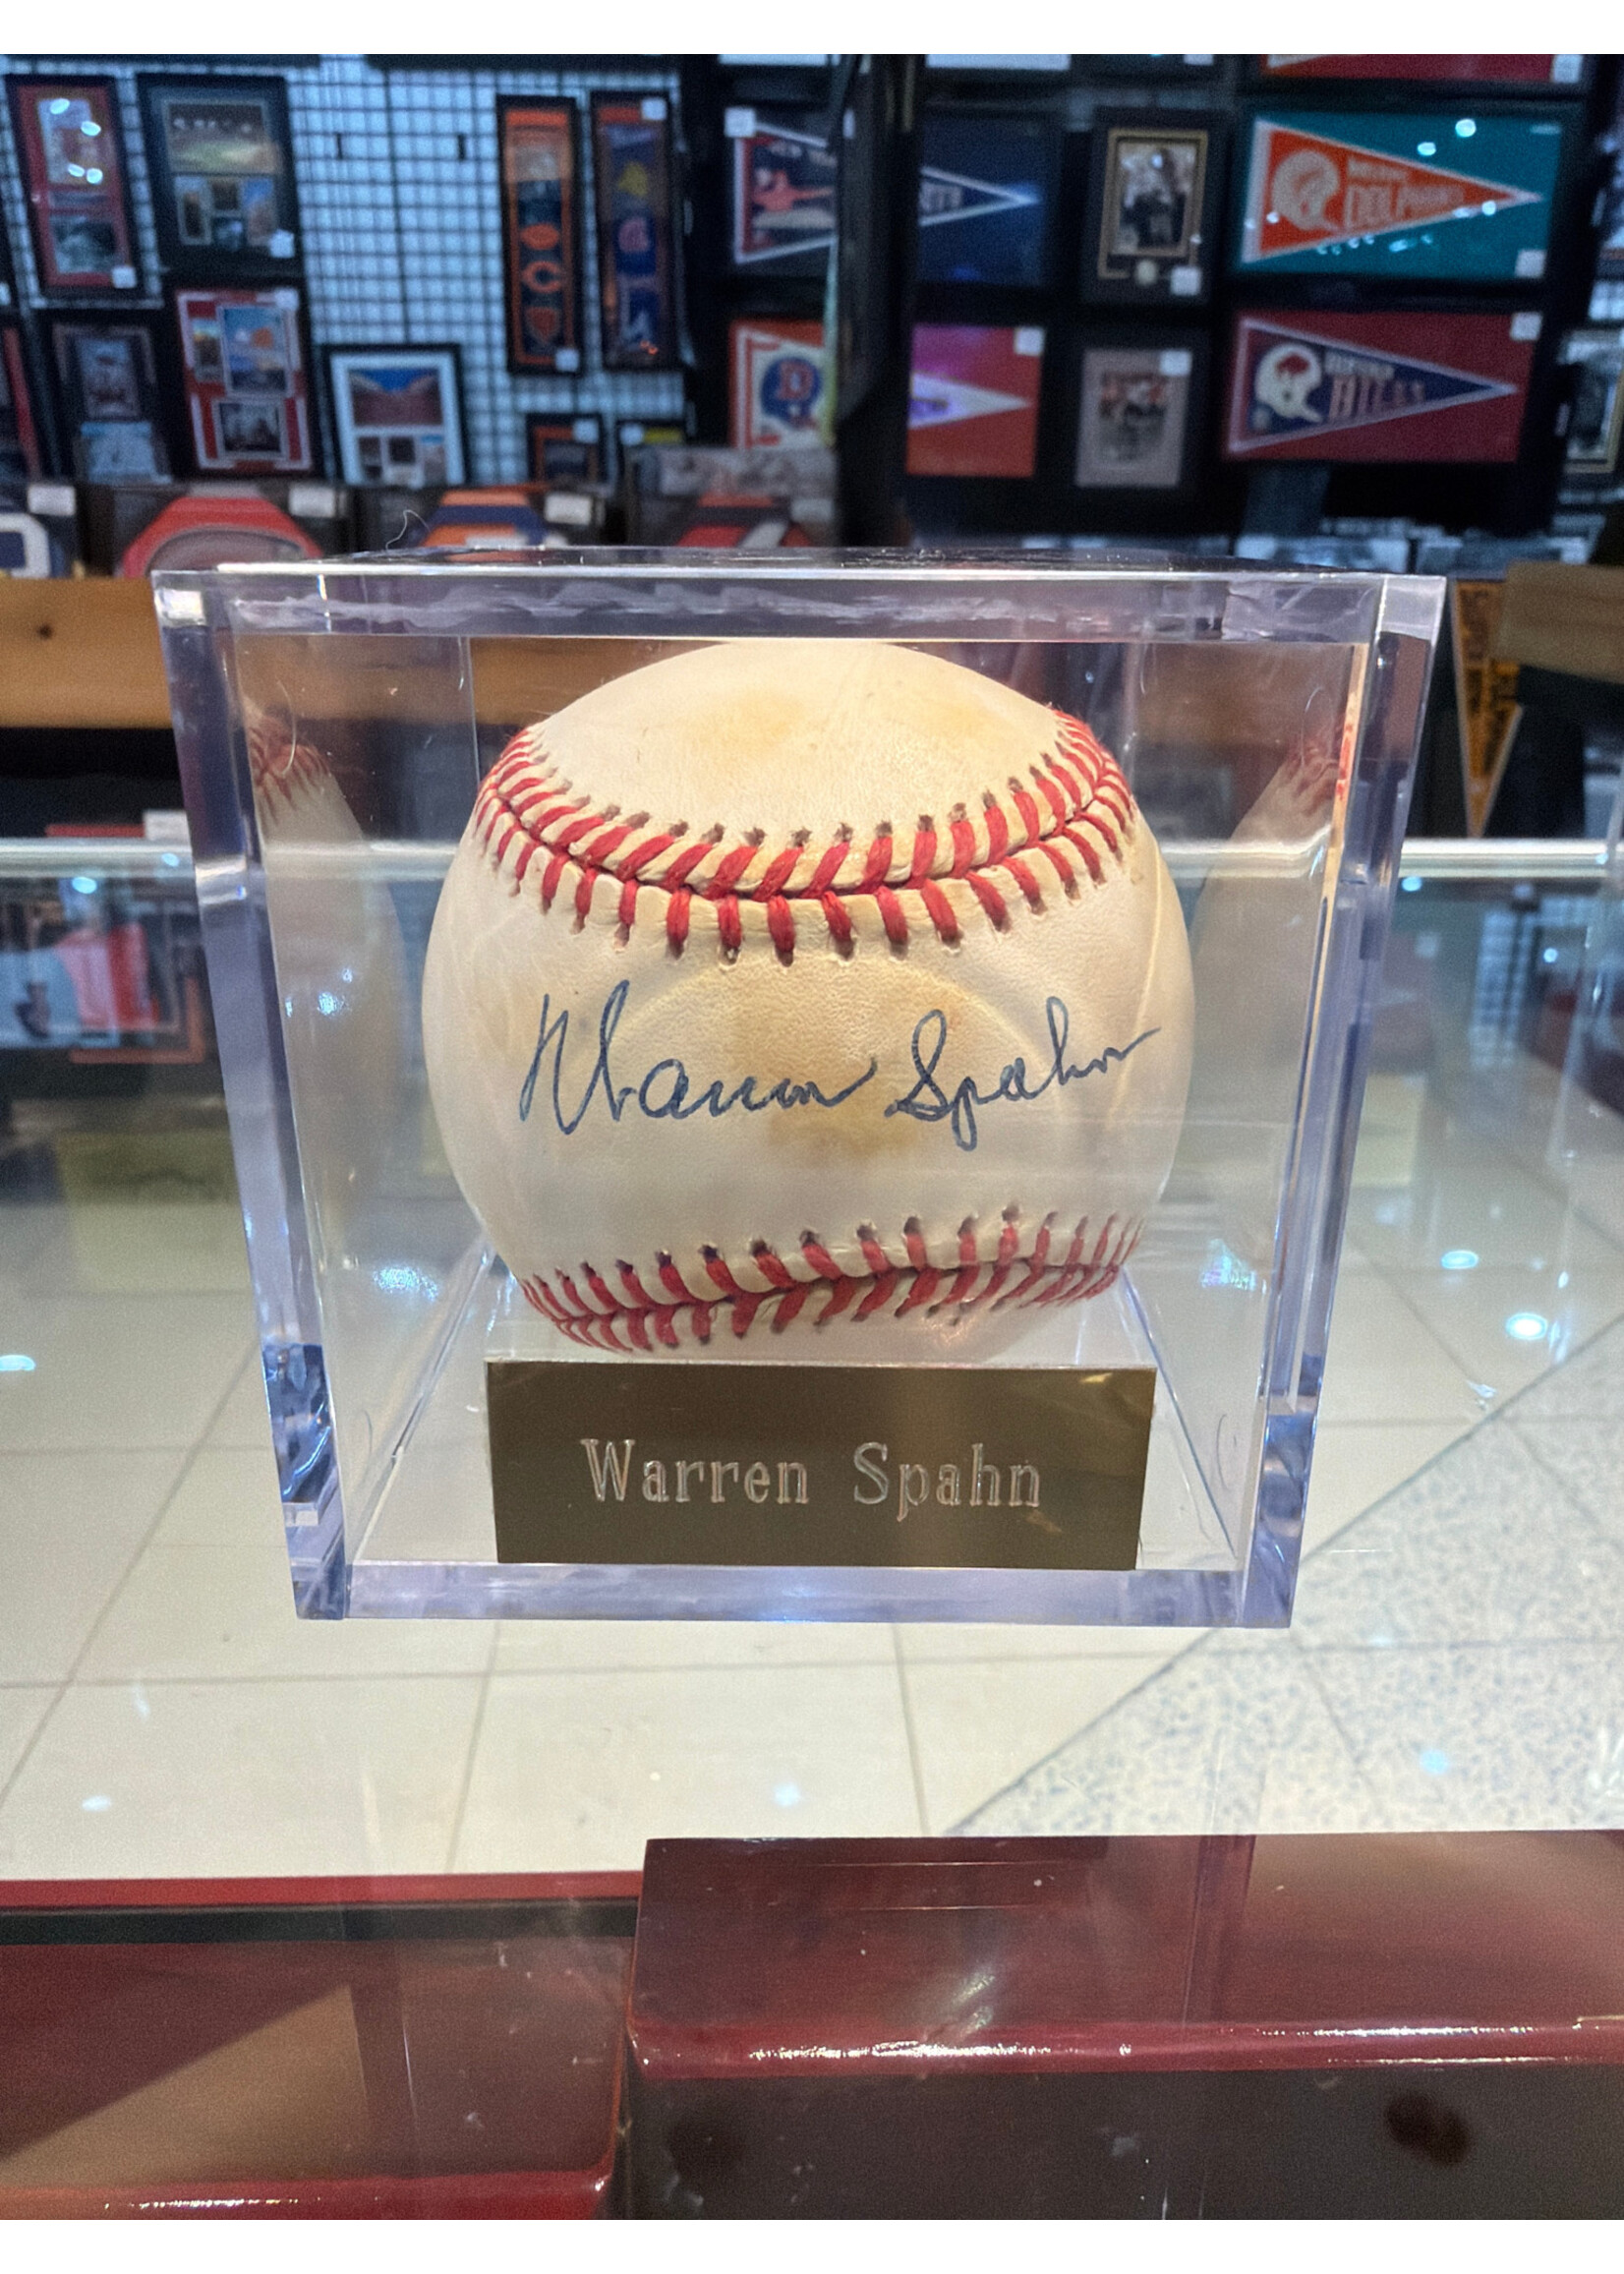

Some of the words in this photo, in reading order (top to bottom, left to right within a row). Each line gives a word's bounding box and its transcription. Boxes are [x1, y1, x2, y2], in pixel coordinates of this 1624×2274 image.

[519, 979, 878, 1135] Warren
[884, 996, 1162, 1151] Spahn
[580, 1438, 809, 1504] Warren
[853, 1441, 1041, 1521] Spahn
